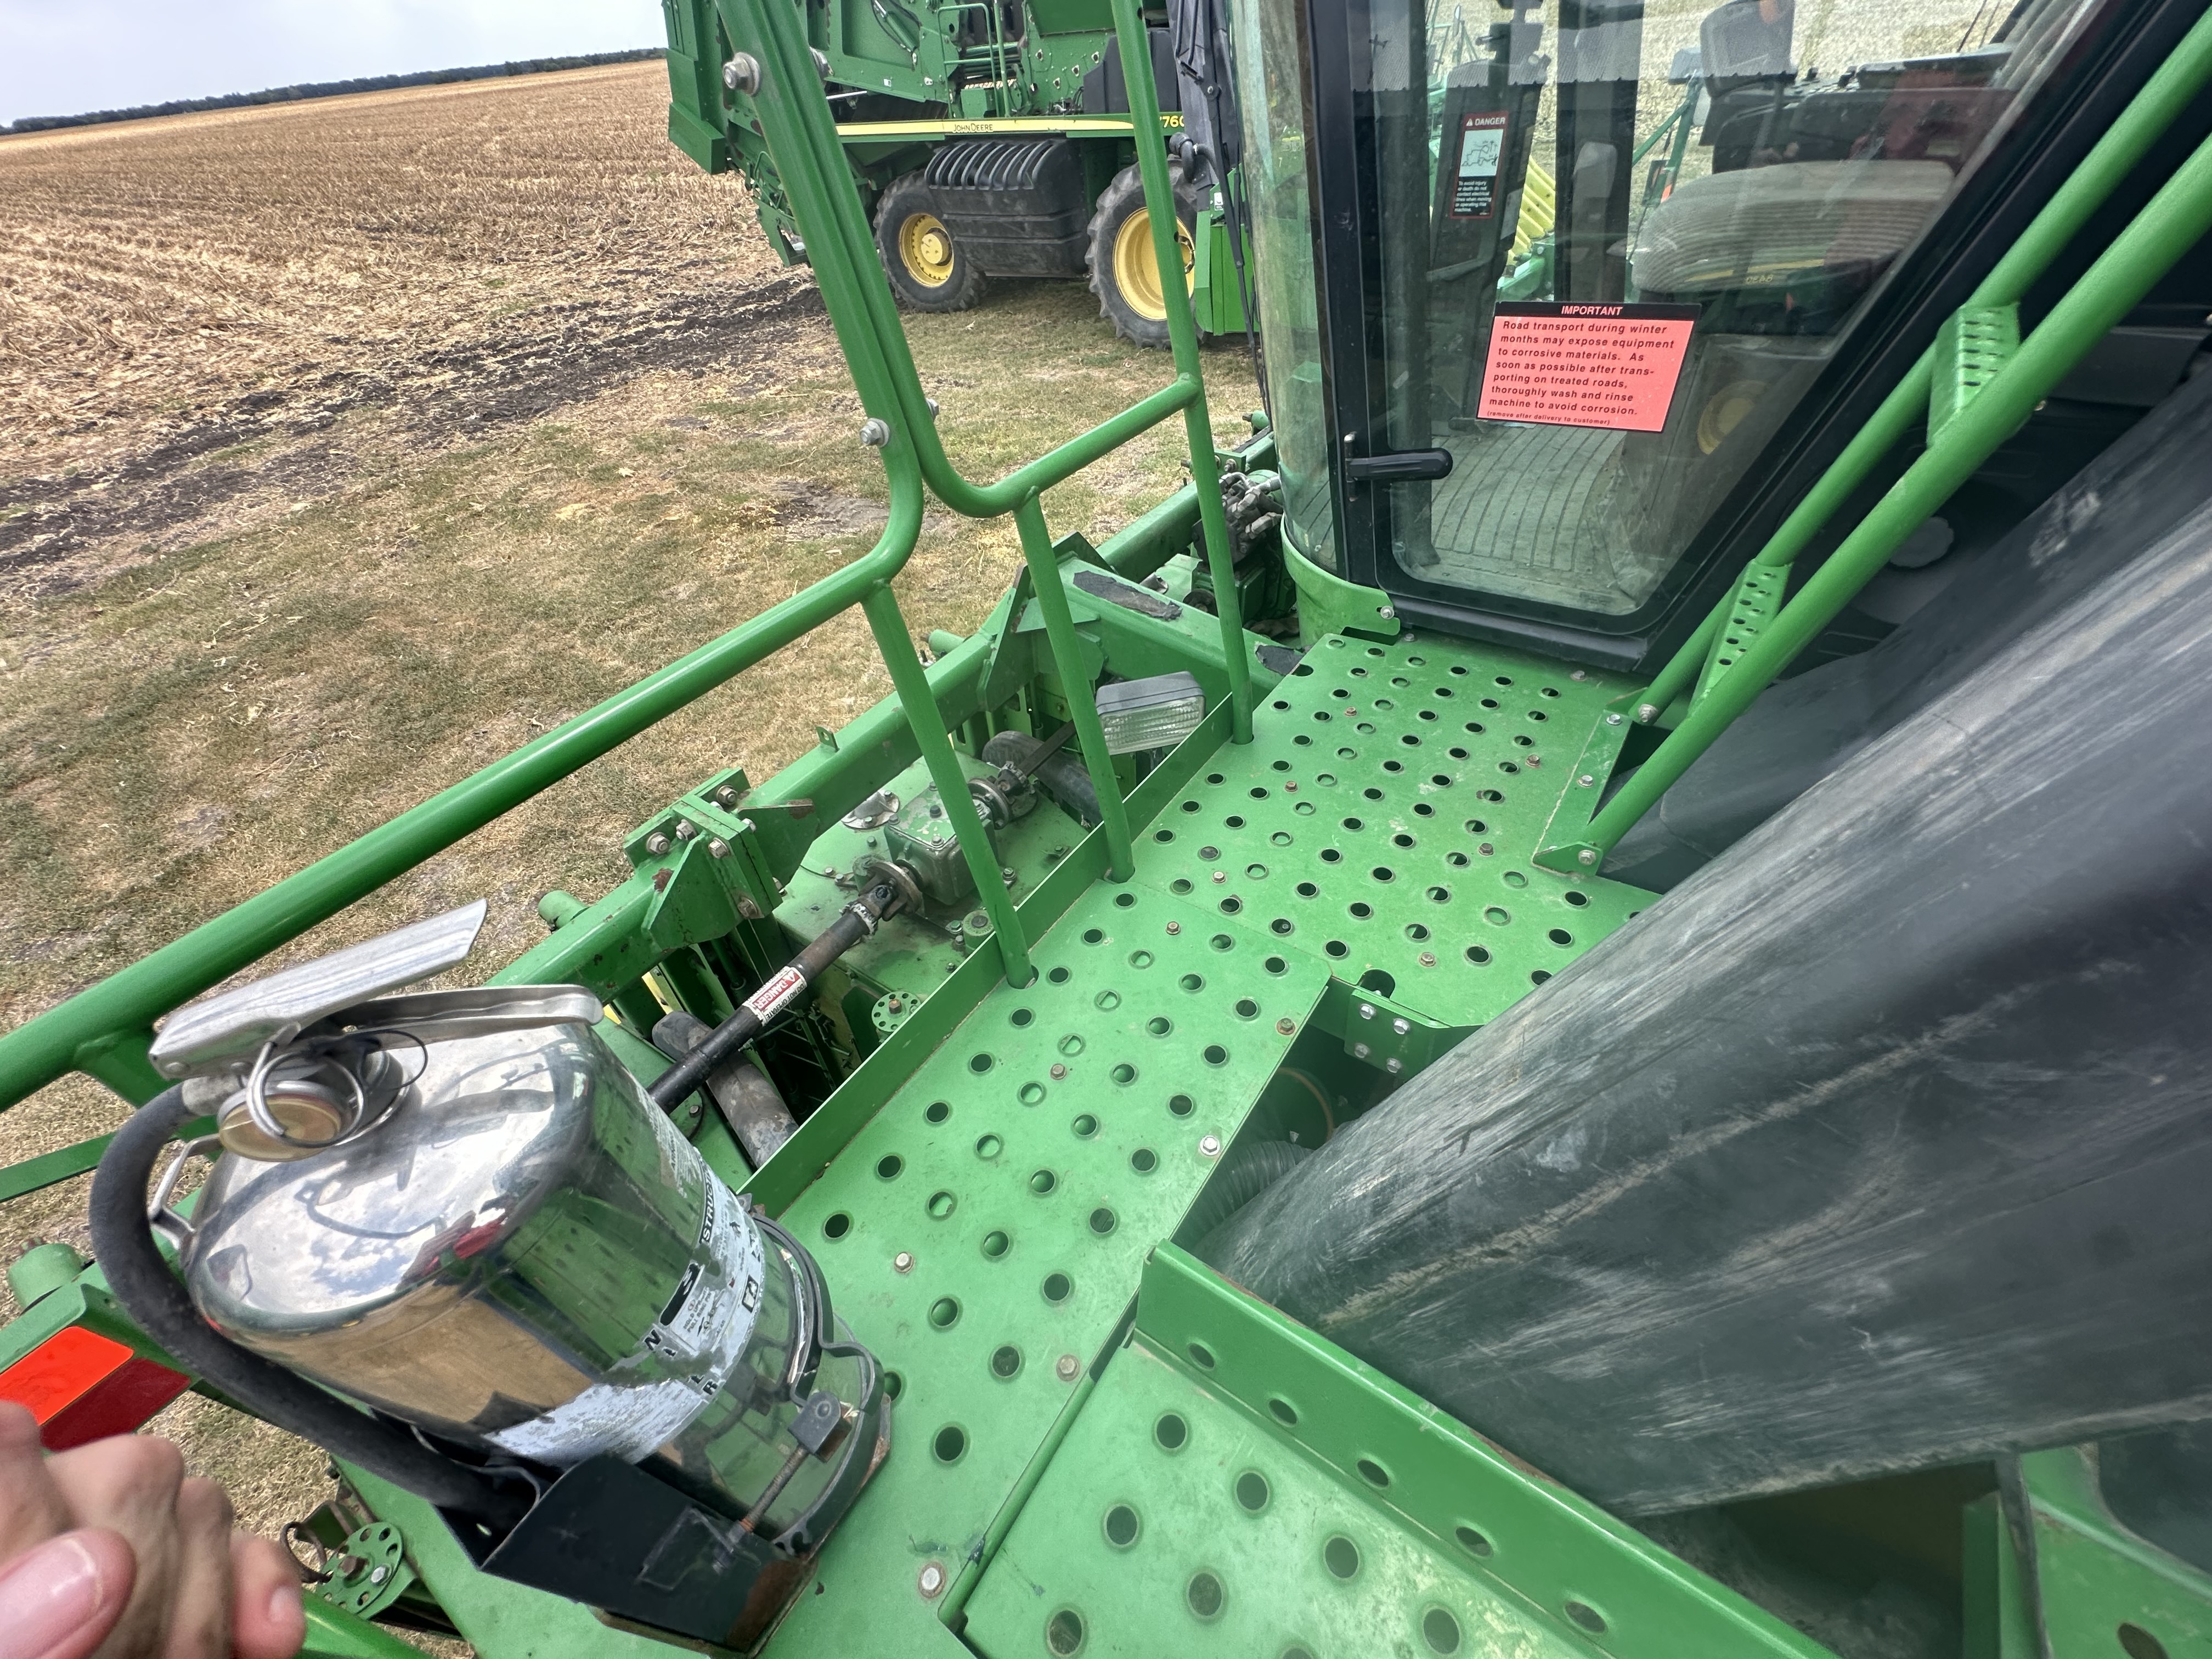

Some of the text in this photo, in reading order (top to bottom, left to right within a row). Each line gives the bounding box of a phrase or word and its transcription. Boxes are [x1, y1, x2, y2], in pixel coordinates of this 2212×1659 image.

[1561, 306, 1623, 315] IMPORTANT
[1503, 321, 1667, 334] Road transport during winter
[1501, 335, 1674, 349] months may expose equipment
[1512, 349, 1561, 358] corrosive
[1566, 351, 1621, 360] materials.
[1629, 353, 1644, 362] As
[1539, 363, 1585, 373] possible
[1589, 365, 1616, 373] after
[1620, 366, 1655, 375] trans-
[1493, 374, 1530, 383] porting
[1551, 377, 1589, 385] treated
[1593, 379, 1627, 389] roads,
[1492, 386, 1547, 398] thoroughly
[1551, 390, 1578, 398] wash
[1581, 391, 1601, 399] and
[1489, 398, 1638, 415] machine to avoid corrosion.
[754, 979, 788, 1009] DANGER
[766, 984, 804, 1018] DO NOT OPERATE
